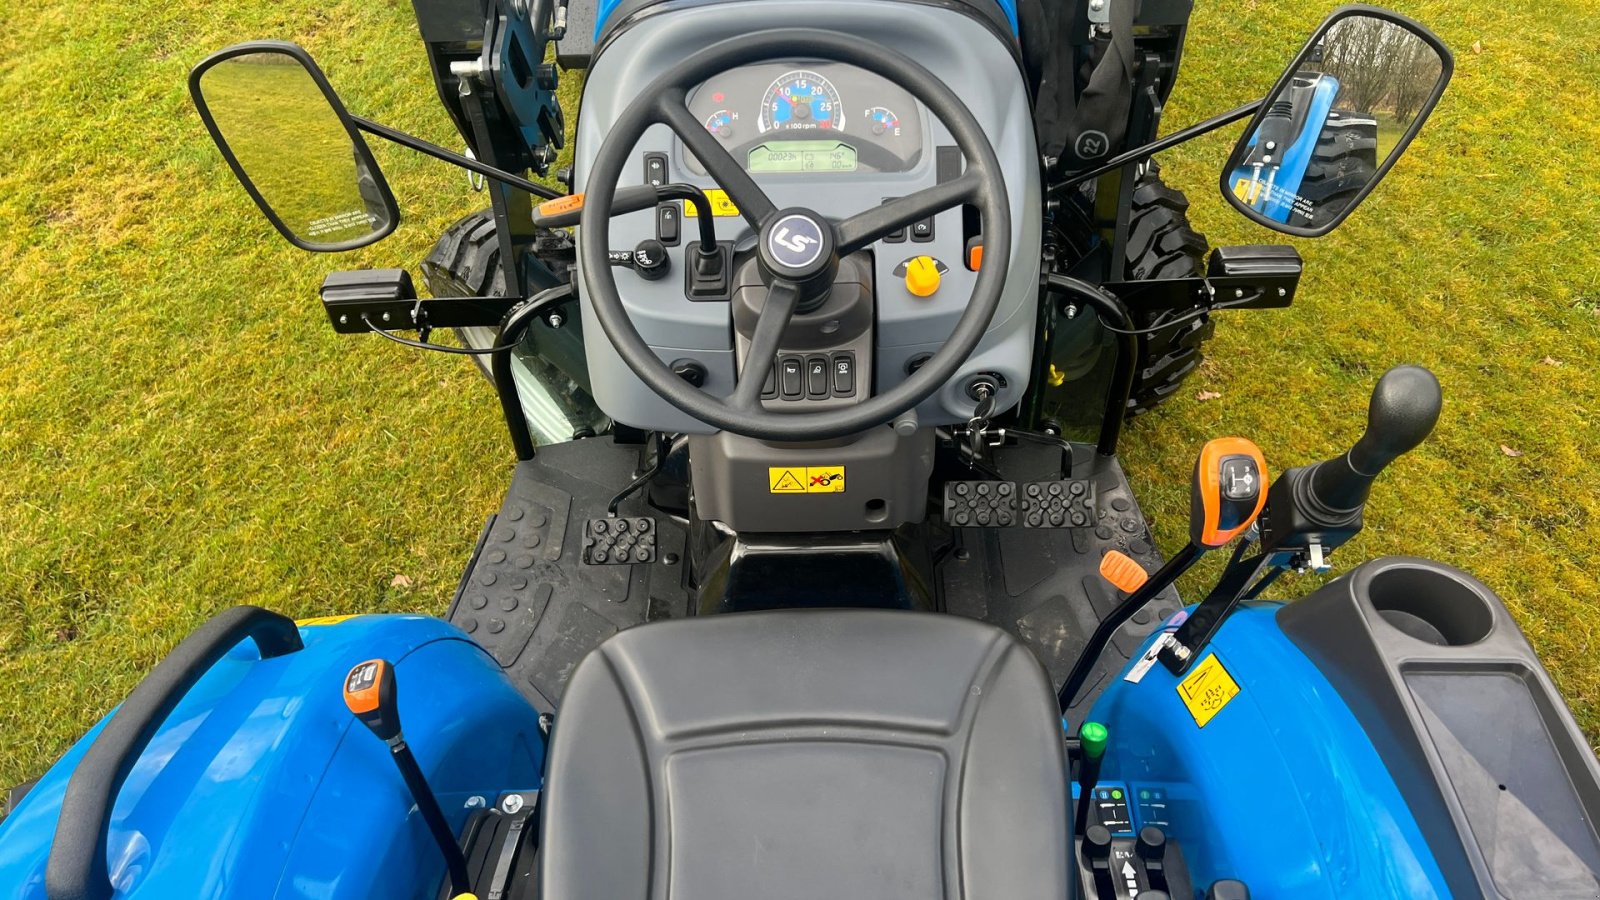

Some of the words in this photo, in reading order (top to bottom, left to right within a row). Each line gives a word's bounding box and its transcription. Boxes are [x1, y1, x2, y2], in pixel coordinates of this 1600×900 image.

[795, 80, 806, 89] 15
[780, 88, 791, 96] 10
[811, 86, 823, 95] 20
[772, 103, 778, 111] 5
[820, 103, 832, 111] 25
[732, 112, 739, 120] H
[865, 109, 871, 118] F
[773, 121, 780, 129] 0
[894, 127, 901, 136] E
[774, 227, 818, 253] LS
